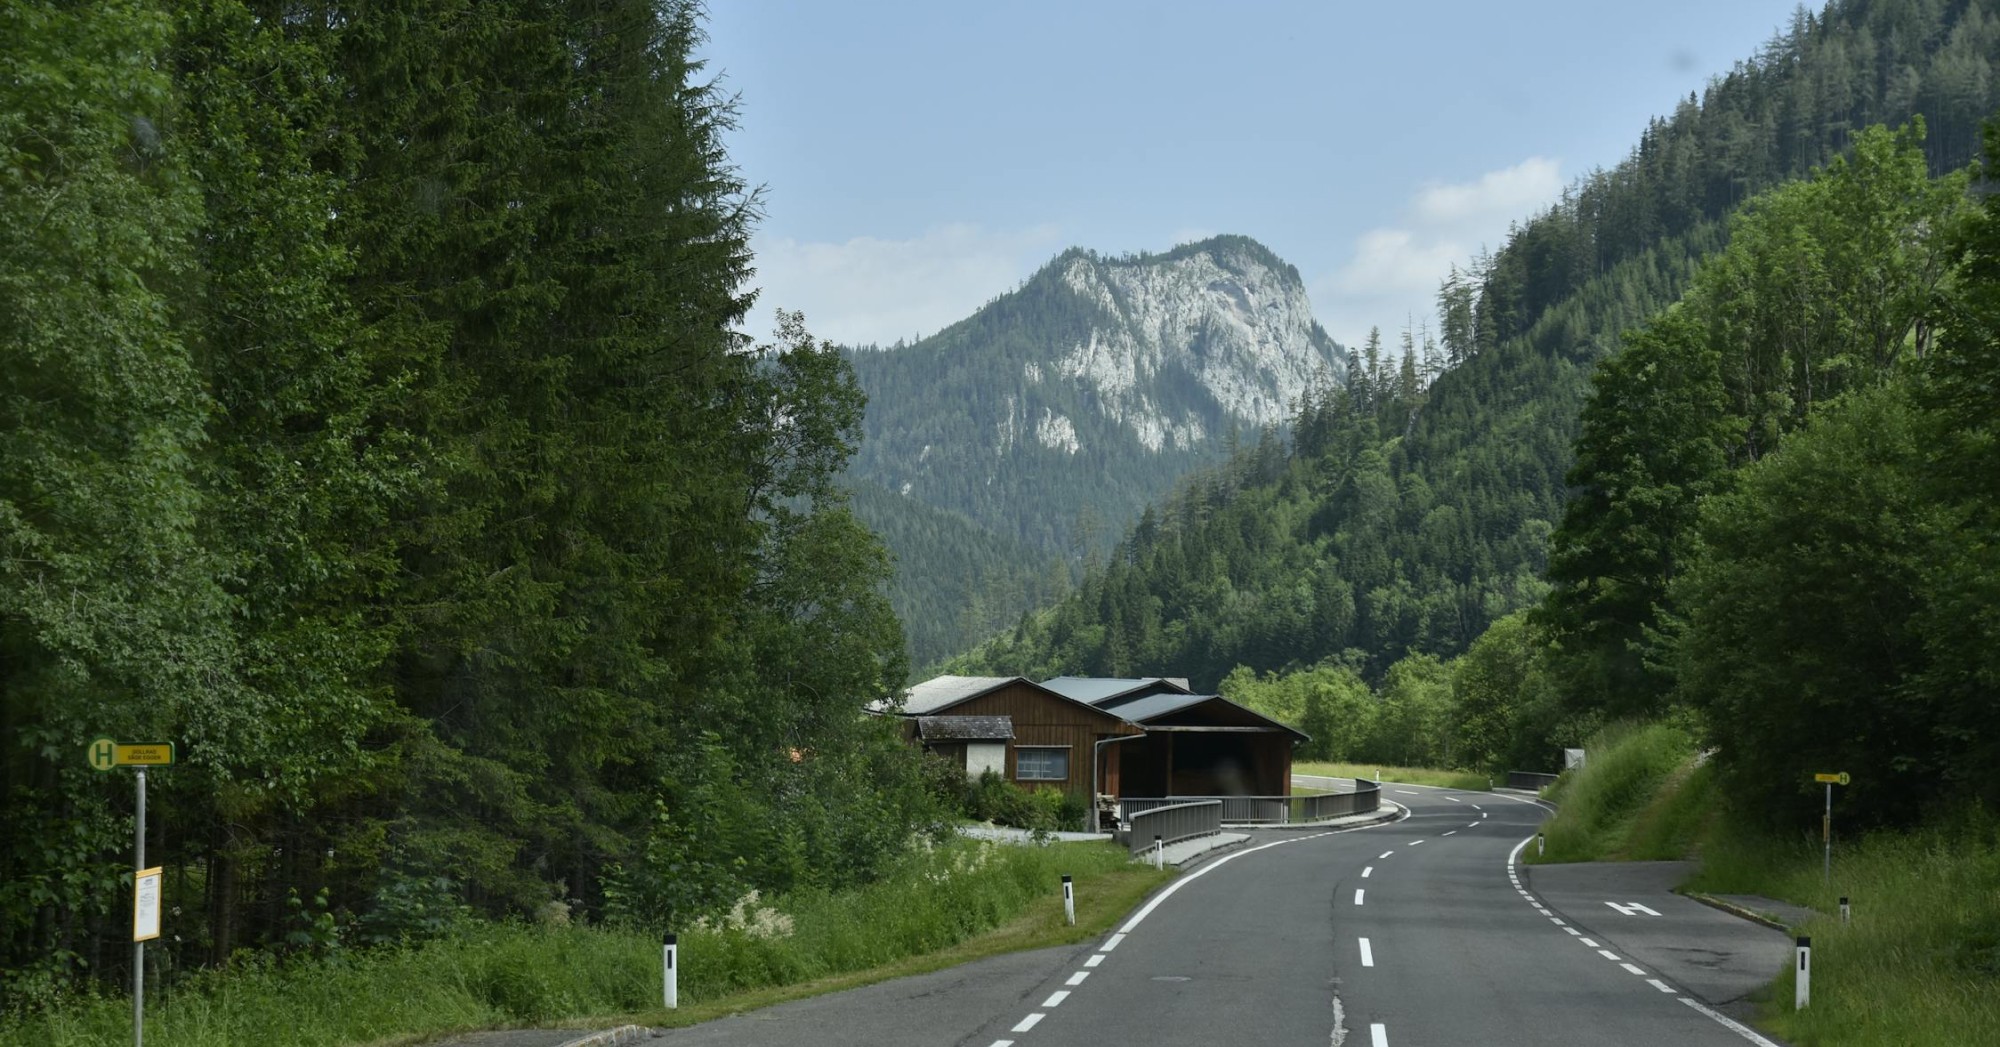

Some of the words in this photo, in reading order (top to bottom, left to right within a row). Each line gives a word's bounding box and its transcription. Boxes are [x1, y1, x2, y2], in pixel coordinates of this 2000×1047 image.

[95, 744, 112, 765] H
[1840, 774, 1847, 783] H
[1604, 901, 1663, 916] H
